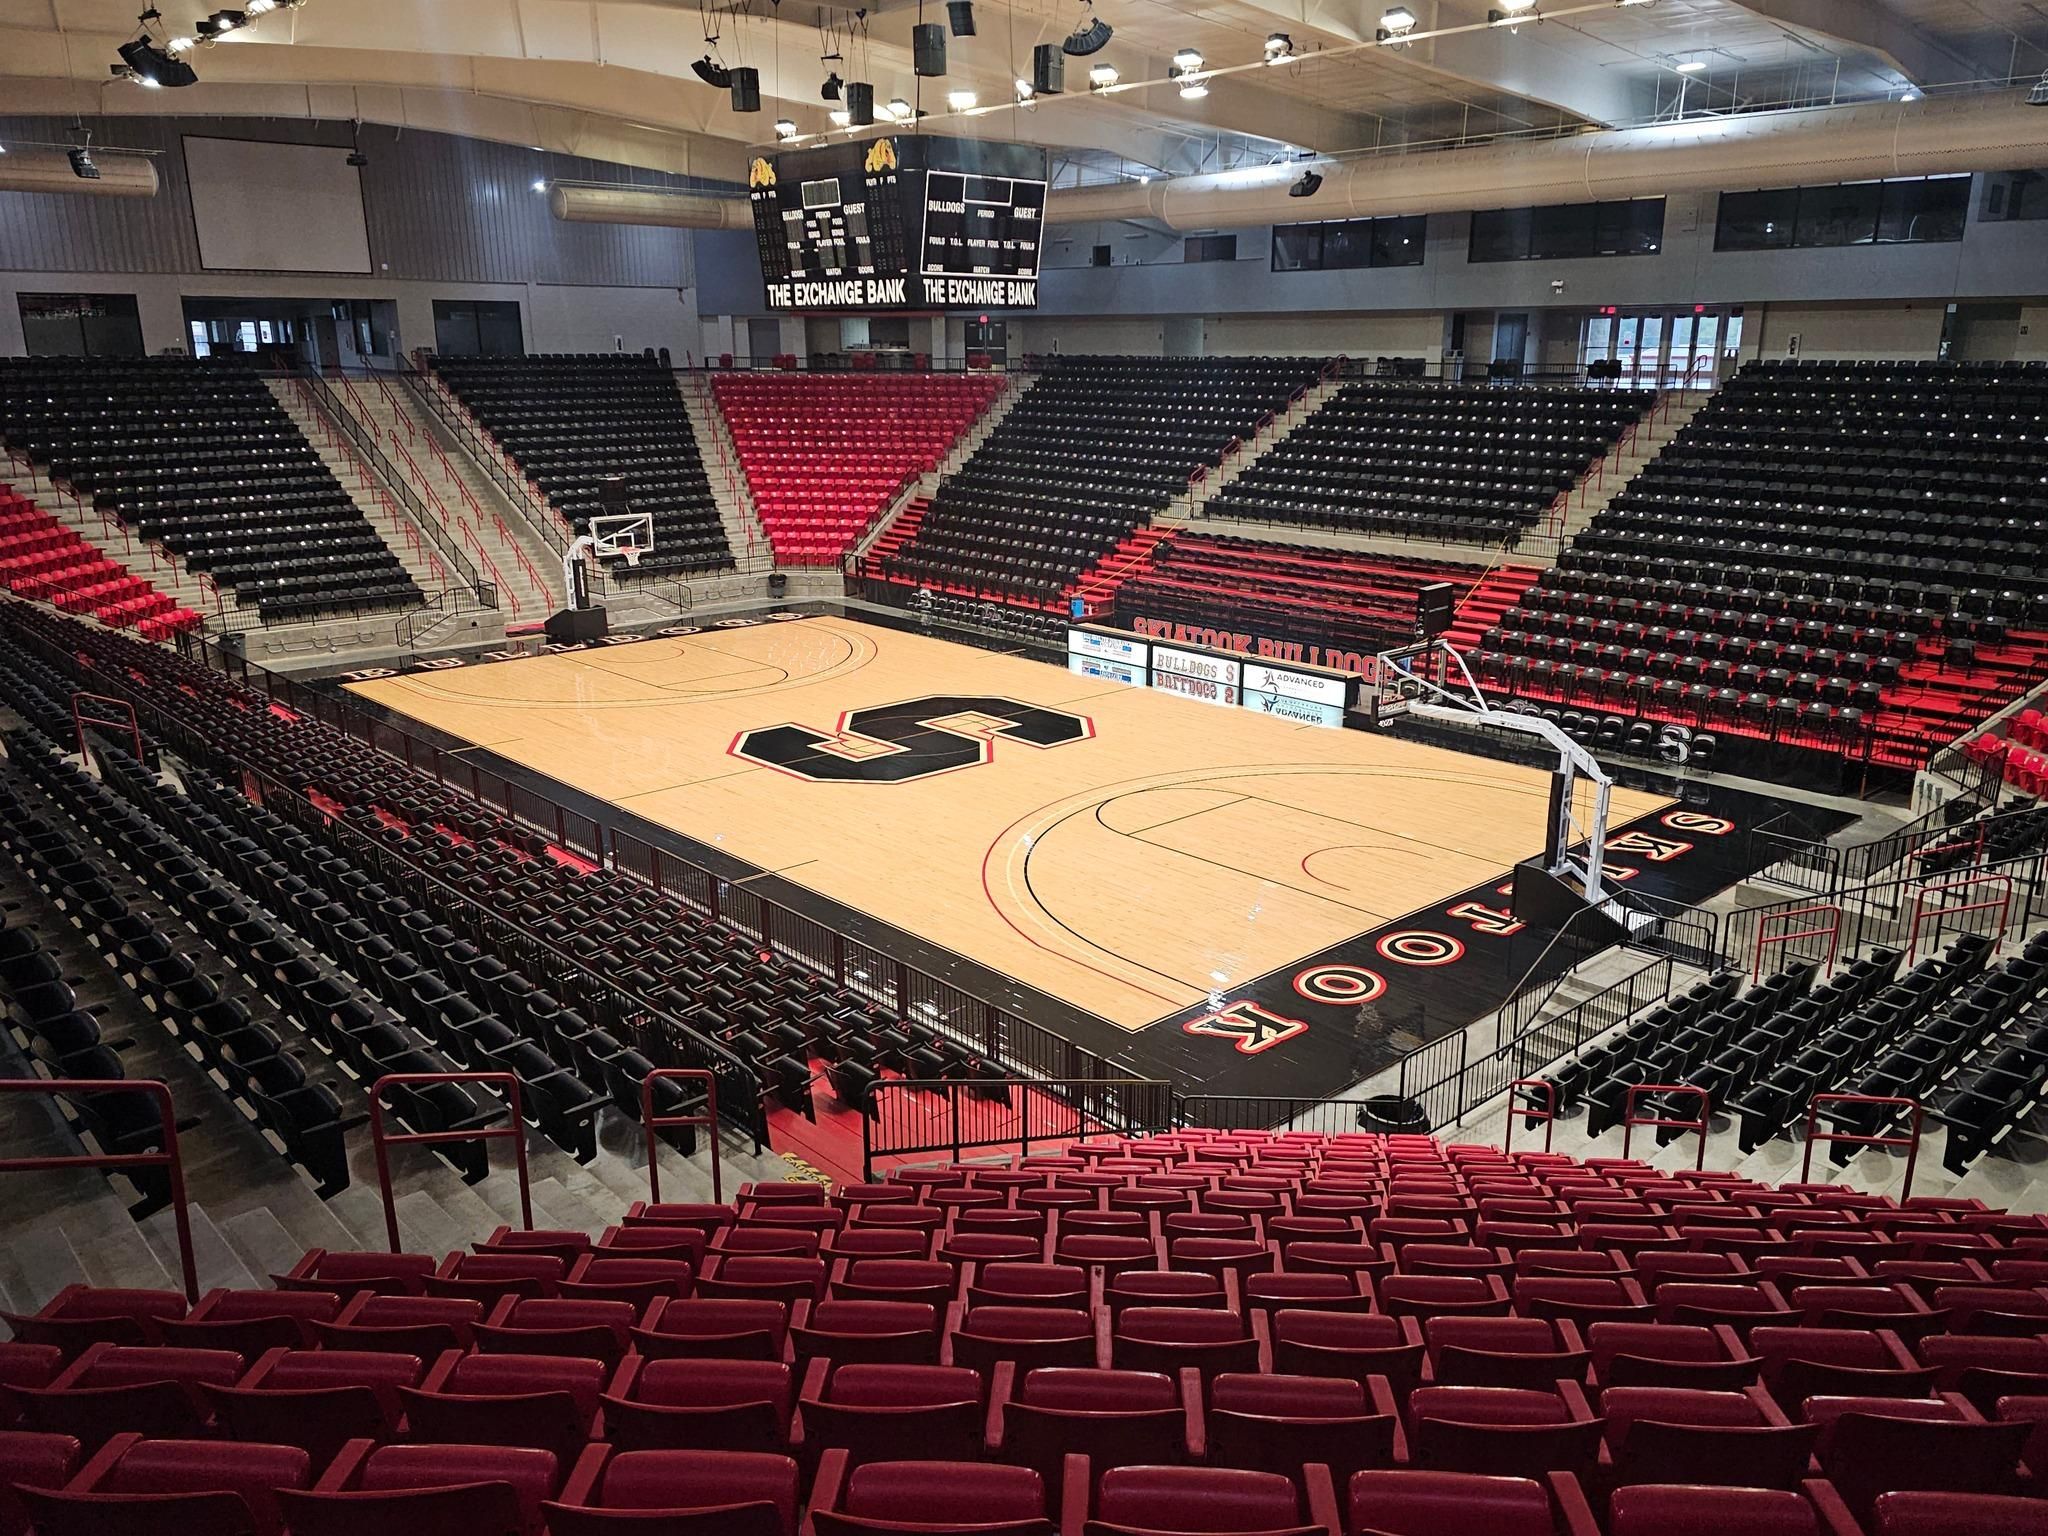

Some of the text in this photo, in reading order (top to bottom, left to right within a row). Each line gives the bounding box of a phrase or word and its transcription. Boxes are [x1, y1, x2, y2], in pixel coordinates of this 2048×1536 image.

[843, 202, 866, 215] GUEST
[928, 200, 966, 214] BULLDOGS
[1013, 206, 1037, 219] GUEST
[782, 209, 804, 222] BULLDOGS
[815, 210, 831, 219] PERIOD
[977, 209, 995, 219] PERIOD
[816, 237, 846, 248] PLAYER FOUL
[855, 235, 871, 244] FOULS
[929, 236, 946, 246] FOULS
[967, 238, 1000, 249] PLAYER FOUL
[787, 241, 801, 250] FOULS
[1019, 241, 1035, 251] FOULS
[791, 269, 806, 278] SCORE
[825, 267, 842, 276] MATCH
[858, 265, 875, 275] SCORE
[927, 263, 944, 273] SCORE
[973, 265, 990, 274] MATCH
[767, 278, 906, 307] THE EXCHANGE BANK
[923, 278, 1036, 306] THE EXCHANGE BANK
[1133, 616, 1253, 653] SKIATOOK
[340, 612, 804, 681] BULLDOGS
[1156, 653, 1218, 679] BULLDOGS
[1276, 673, 1326, 690] ADVANCED
[725, 694, 1096, 785] S
